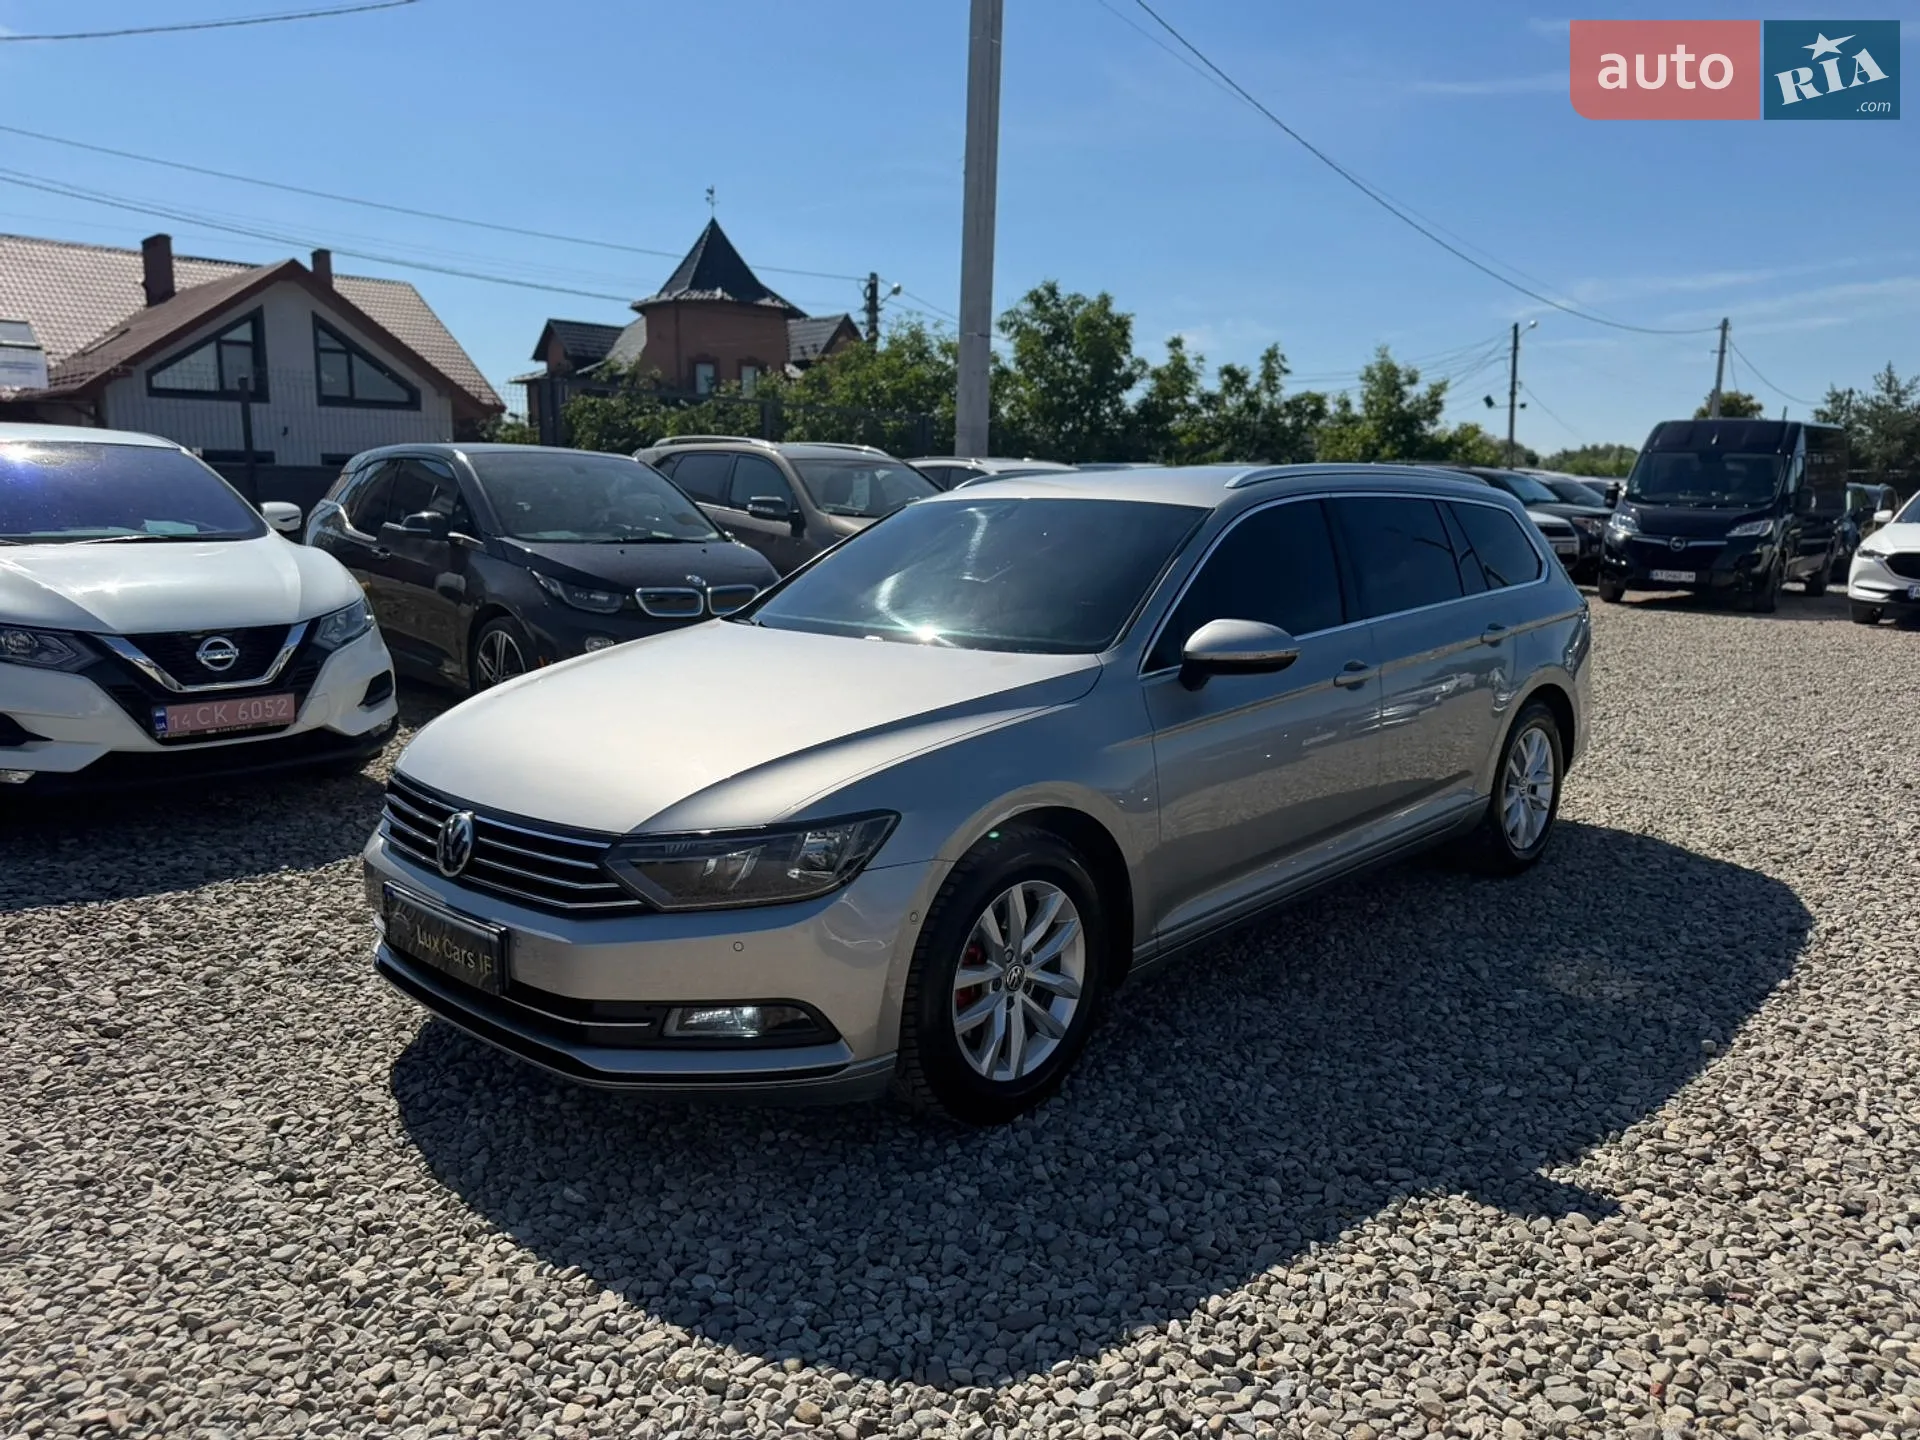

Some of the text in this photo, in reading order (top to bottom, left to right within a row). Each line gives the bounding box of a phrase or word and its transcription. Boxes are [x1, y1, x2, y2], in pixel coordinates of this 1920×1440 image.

[170, 698, 288, 729] 14 CK 6052
[417, 923, 493, 974] Lux Cars IF
